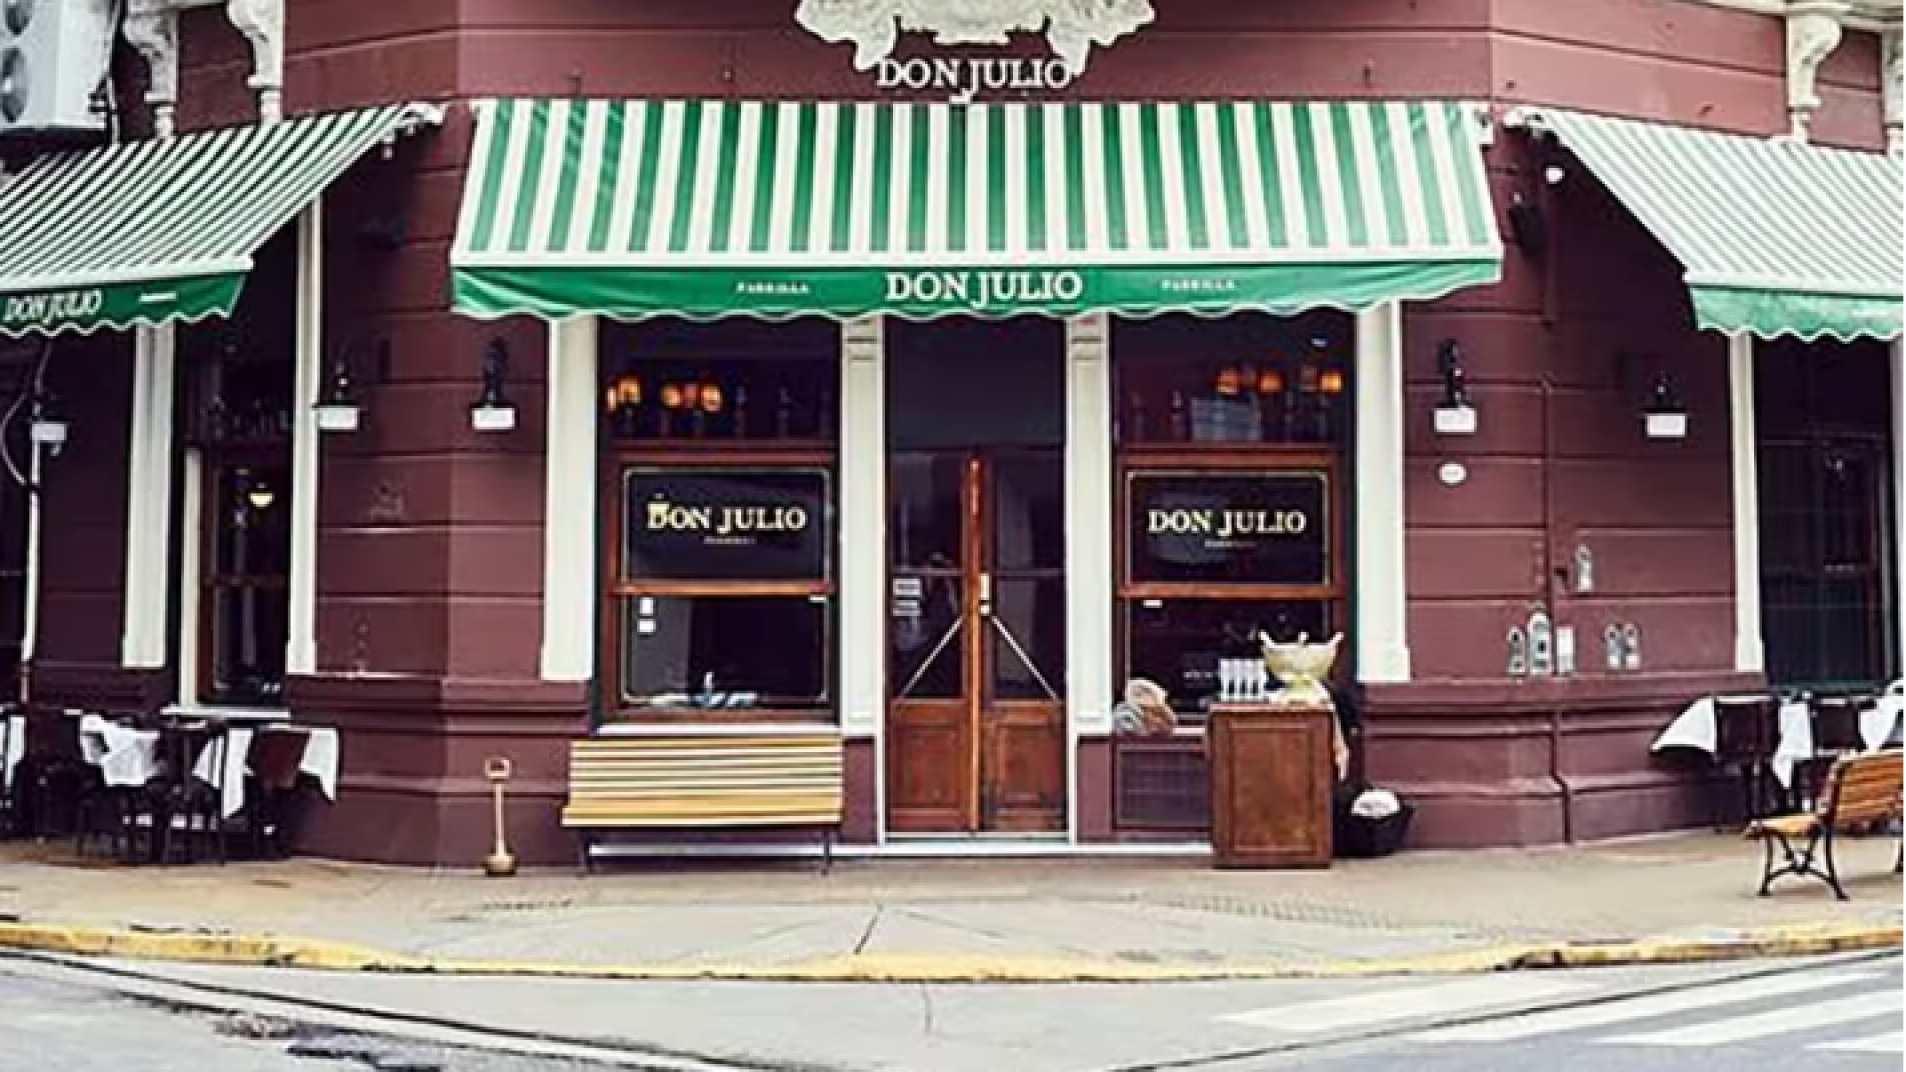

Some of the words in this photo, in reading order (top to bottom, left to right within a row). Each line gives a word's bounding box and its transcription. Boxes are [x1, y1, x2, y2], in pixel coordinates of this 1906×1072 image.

[876, 57, 959, 87] DON
[949, 57, 1070, 104] JULIO
[3, 293, 49, 322] DON
[43, 289, 102, 325] JULIO
[885, 271, 970, 300] DON
[970, 271, 1083, 309] JULIO
[647, 503, 713, 530] DON
[716, 506, 808, 534] JULIO
[1148, 509, 1213, 533] DON
[1217, 509, 1307, 537] JULIO
